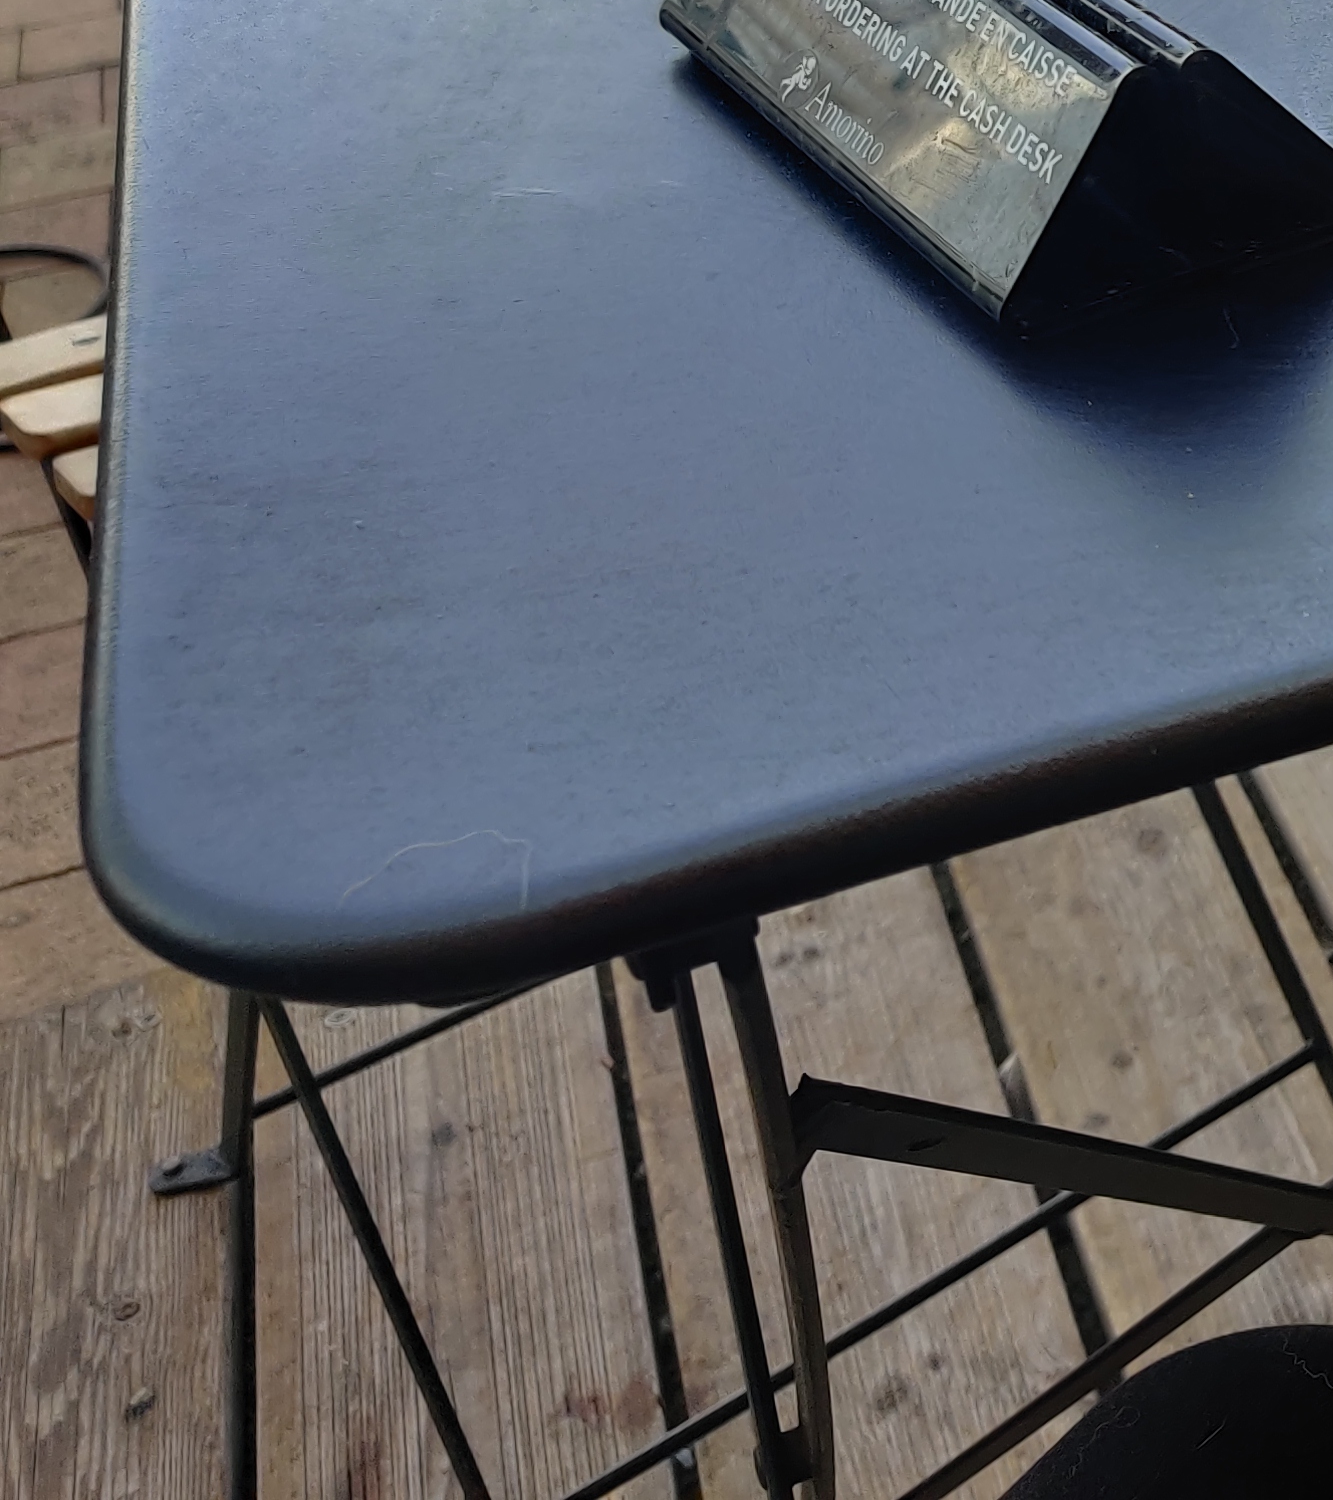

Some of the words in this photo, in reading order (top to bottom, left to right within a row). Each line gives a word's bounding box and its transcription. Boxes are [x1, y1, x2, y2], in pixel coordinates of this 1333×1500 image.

[979, 10, 1010, 47] EN
[1008, 30, 1078, 97] CAISSE
[803, 81, 885, 166] Amorino
[900, 45, 932, 80] AT
[925, 59, 965, 109] THE
[959, 89, 1013, 144] CASH
[1006, 123, 1063, 185] DESK
